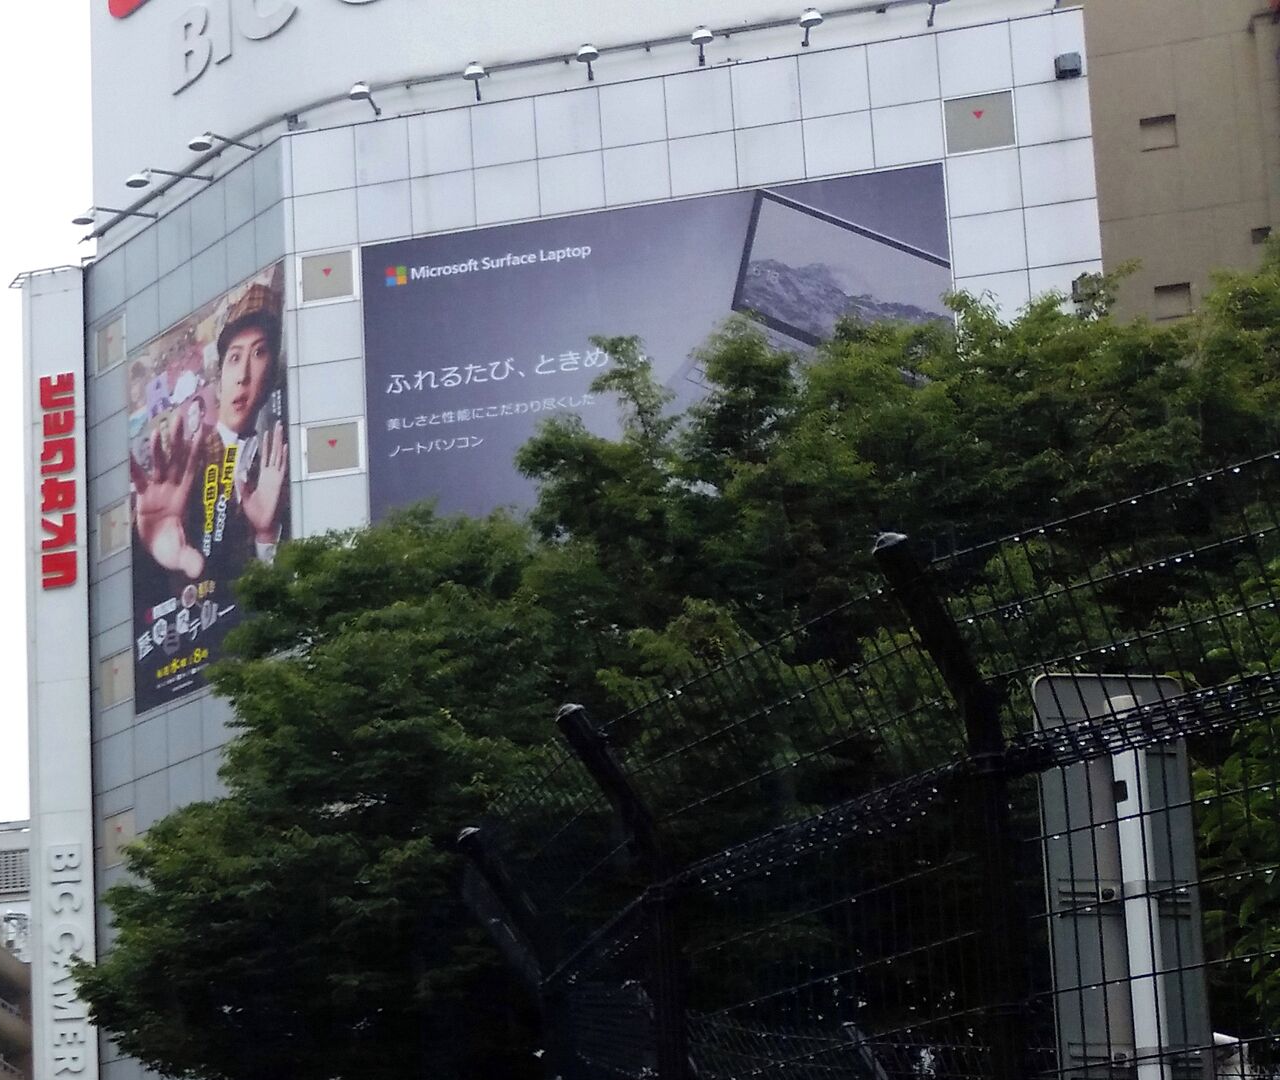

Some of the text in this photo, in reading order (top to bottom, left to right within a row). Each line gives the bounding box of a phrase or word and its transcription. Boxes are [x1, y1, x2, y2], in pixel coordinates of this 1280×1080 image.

[410, 246, 592, 280] Microsoft Surface Laptop
[386, 393, 597, 431] 美しさと性能にこだわり尽くした
[389, 435, 484, 457] ノートパソコン
[48, 844, 83, 914] BIC
